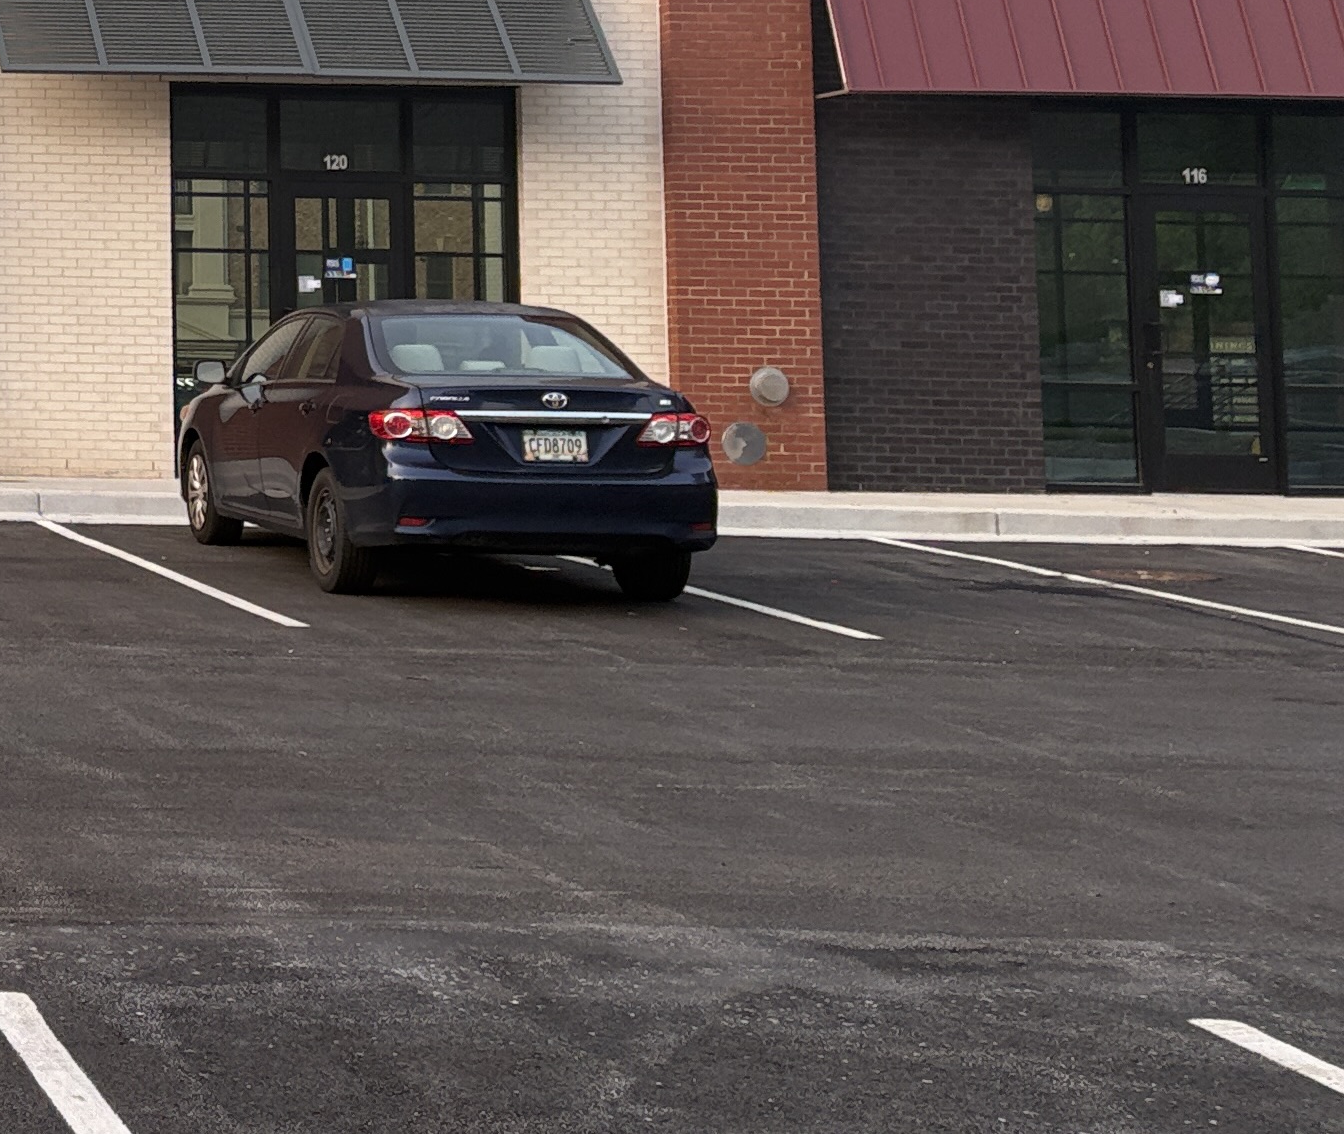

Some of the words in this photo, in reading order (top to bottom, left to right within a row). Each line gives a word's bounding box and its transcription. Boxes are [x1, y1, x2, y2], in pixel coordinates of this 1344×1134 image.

[323, 154, 348, 170] 120
[1182, 168, 1207, 185] 116
[529, 437, 583, 455] CFD8709
